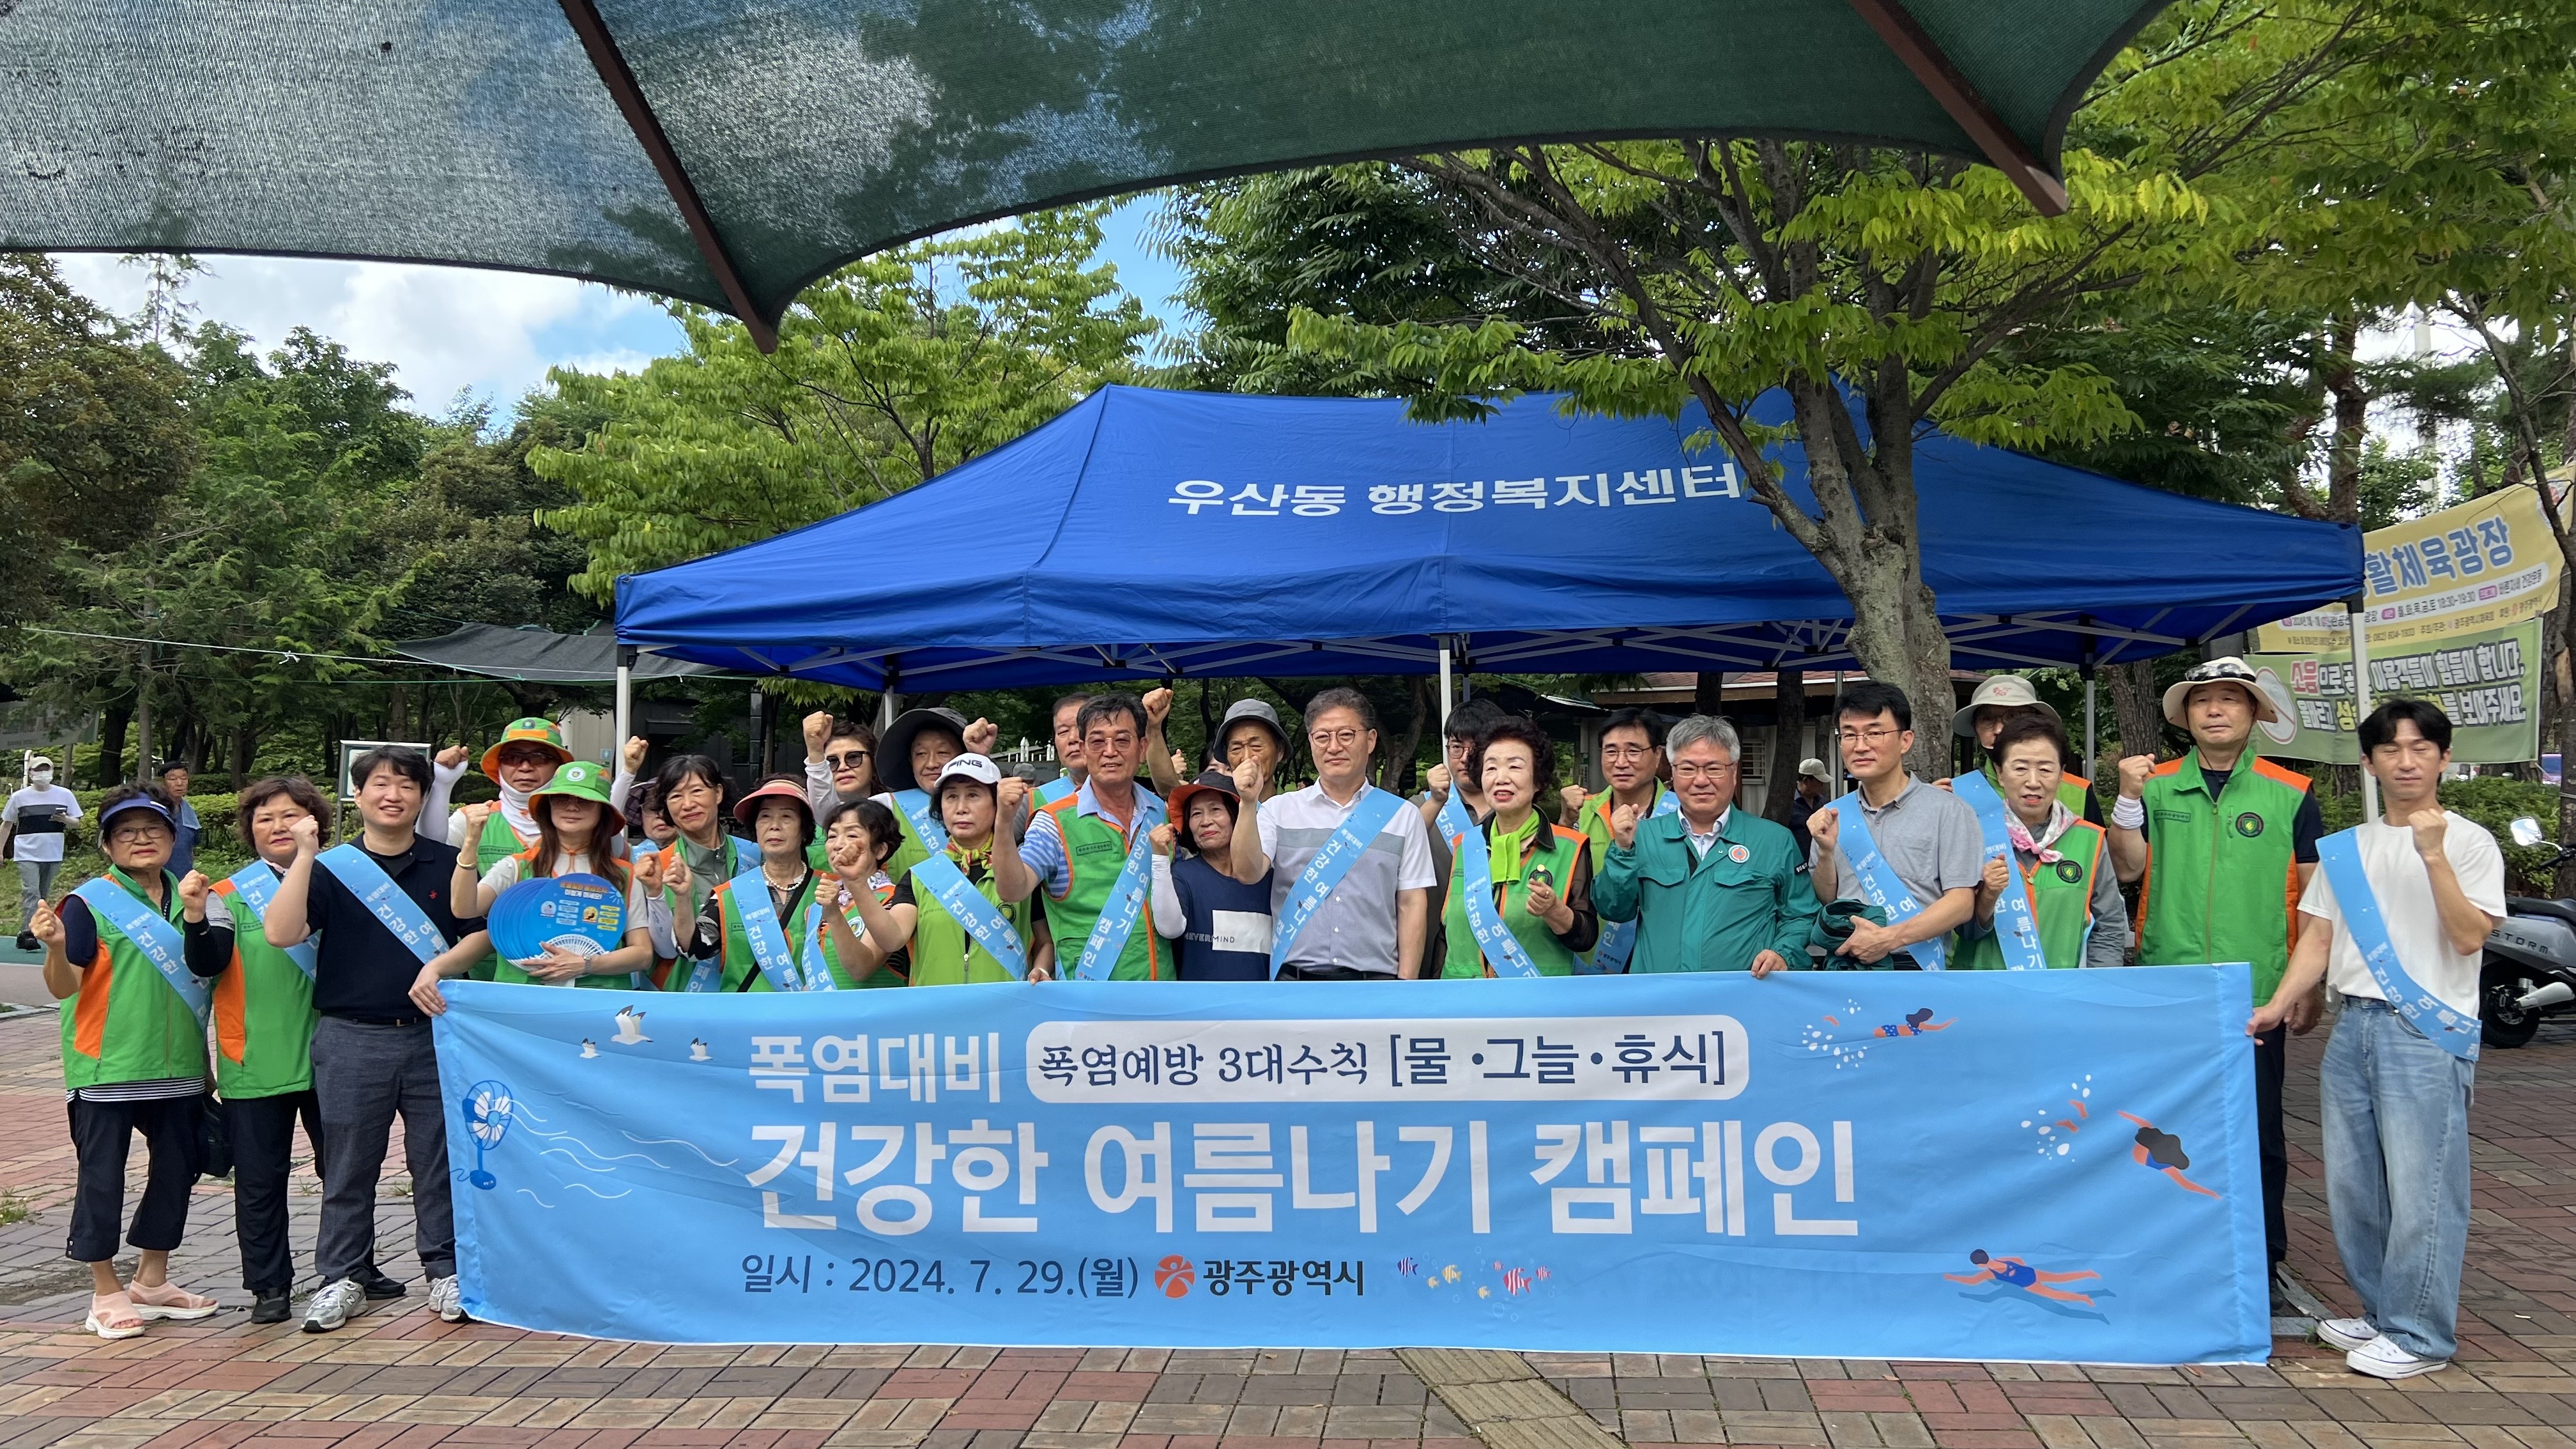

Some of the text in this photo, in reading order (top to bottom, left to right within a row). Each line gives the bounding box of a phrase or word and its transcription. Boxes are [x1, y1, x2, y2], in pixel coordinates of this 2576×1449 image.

[1169, 463, 1740, 516] 우산동 행정복지센터
[2364, 516, 2513, 595] 활체육광장
[2292, 659, 2345, 695] 소음으로
[2370, 653, 2438, 692] 이용객들이
[2435, 649, 2478, 686] 힘들어
[947, 759, 983, 771] PING
[1436, 809, 1455, 847] 건강
[1303, 839, 1342, 884] 건강한
[1116, 871, 1149, 936] 여름나기
[1286, 881, 1330, 940] 여름나기
[1466, 896, 1491, 944] 건강한
[1862, 873, 1899, 921] 건강한
[376, 903, 420, 946] 건강한
[747, 924, 774, 971] 건강한
[949, 900, 1024, 957] 건강한 여름나
[1083, 916, 1114, 969] 캠페인
[2011, 897, 2043, 969] 여름나기
[2490, 928, 2549, 955] STORM
[136, 931, 180, 976] 건강한
[689, 957, 714, 992] 페인
[2374, 966, 2422, 1020] 건강한
[749, 1032, 1000, 1103] 폭염대비
[1038, 1043, 1204, 1087] 폭염예방
[1219, 1042, 1367, 1085] 3대수칙
[746, 1119, 1859, 1236] 건강한 여름나기 캠페인
[741, 1254, 811, 1294] 일시
[849, 1257, 954, 1294] 2024.
[970, 1260, 1001, 1295] 7.
[1017, 1256, 1138, 1299] 29.(월)
[1203, 1259, 1364, 1297] 광주광역시
